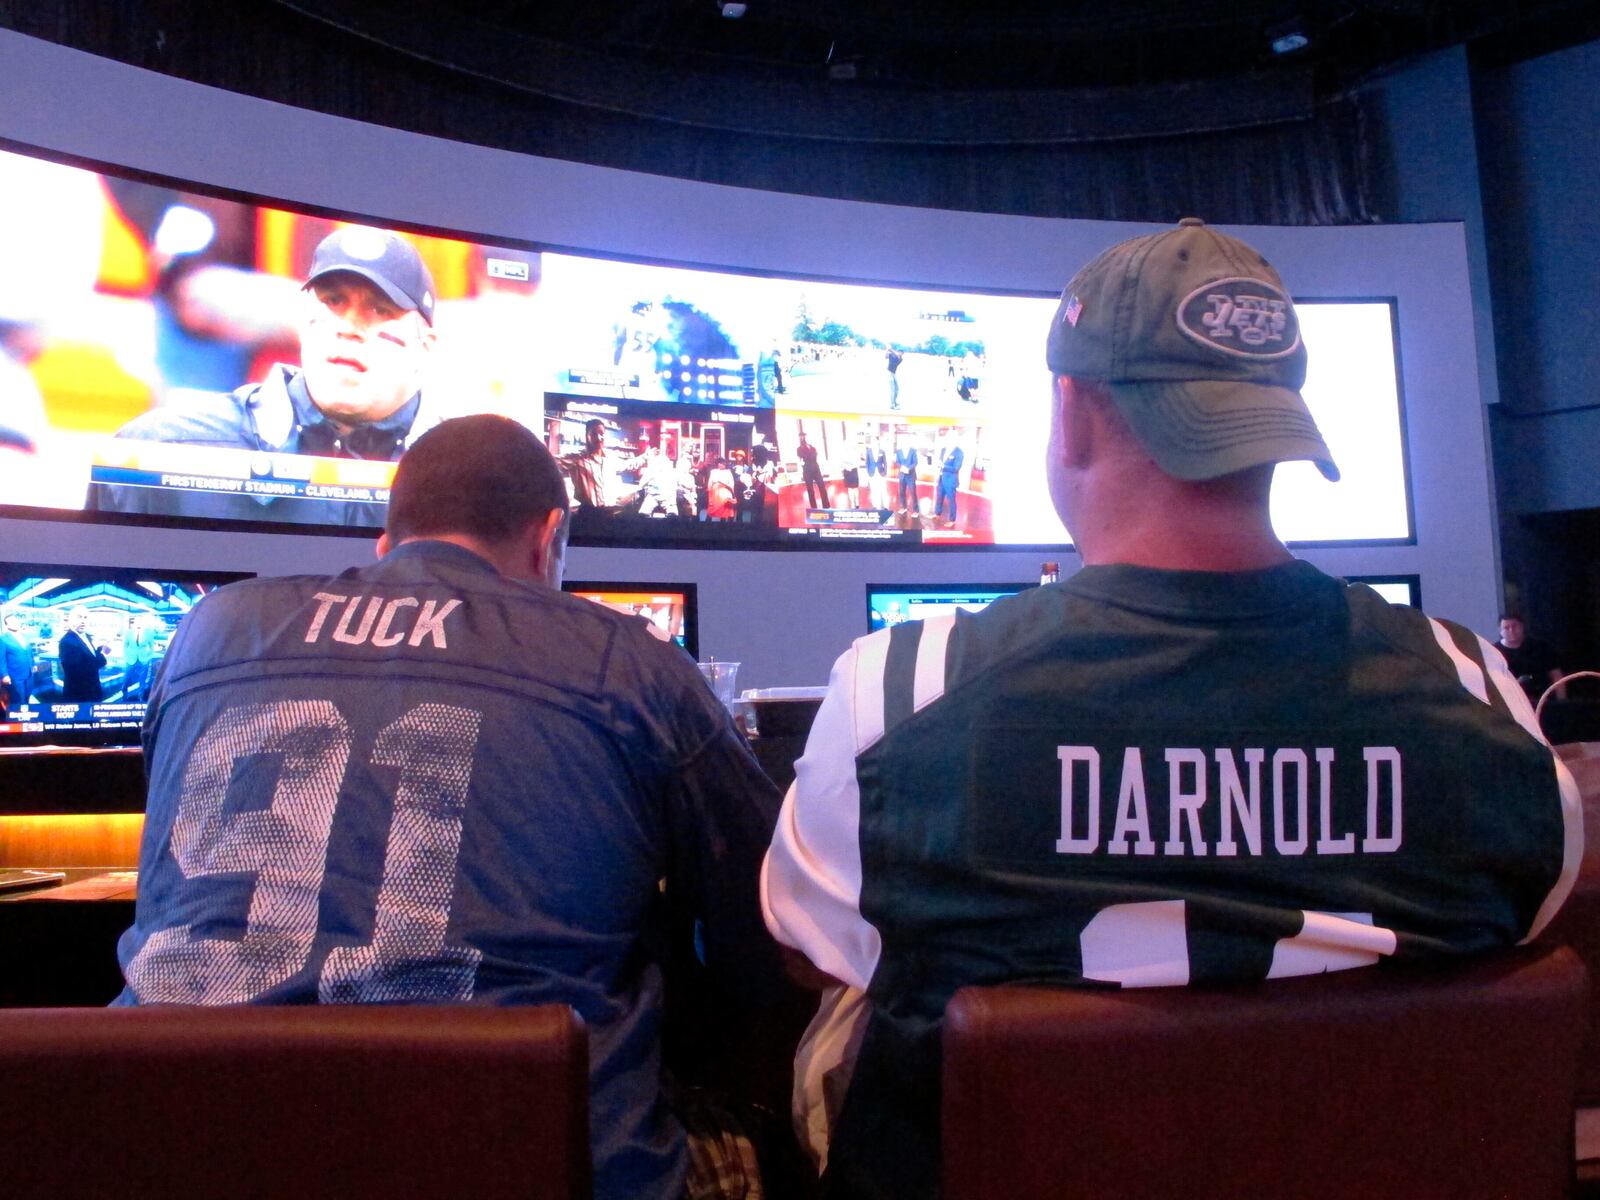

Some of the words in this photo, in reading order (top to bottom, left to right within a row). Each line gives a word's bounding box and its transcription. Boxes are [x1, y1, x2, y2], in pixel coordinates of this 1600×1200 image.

[1202, 297, 1286, 334] JETS
[161, 474, 243, 491] FIRSTENERGY
[245, 481, 295, 495] STADIUM
[305, 487, 373, 500] CLEVELAND,
[304, 592, 463, 648] TUCK
[1055, 745, 1402, 856] DARNOLD
[126, 700, 483, 1006] 91
